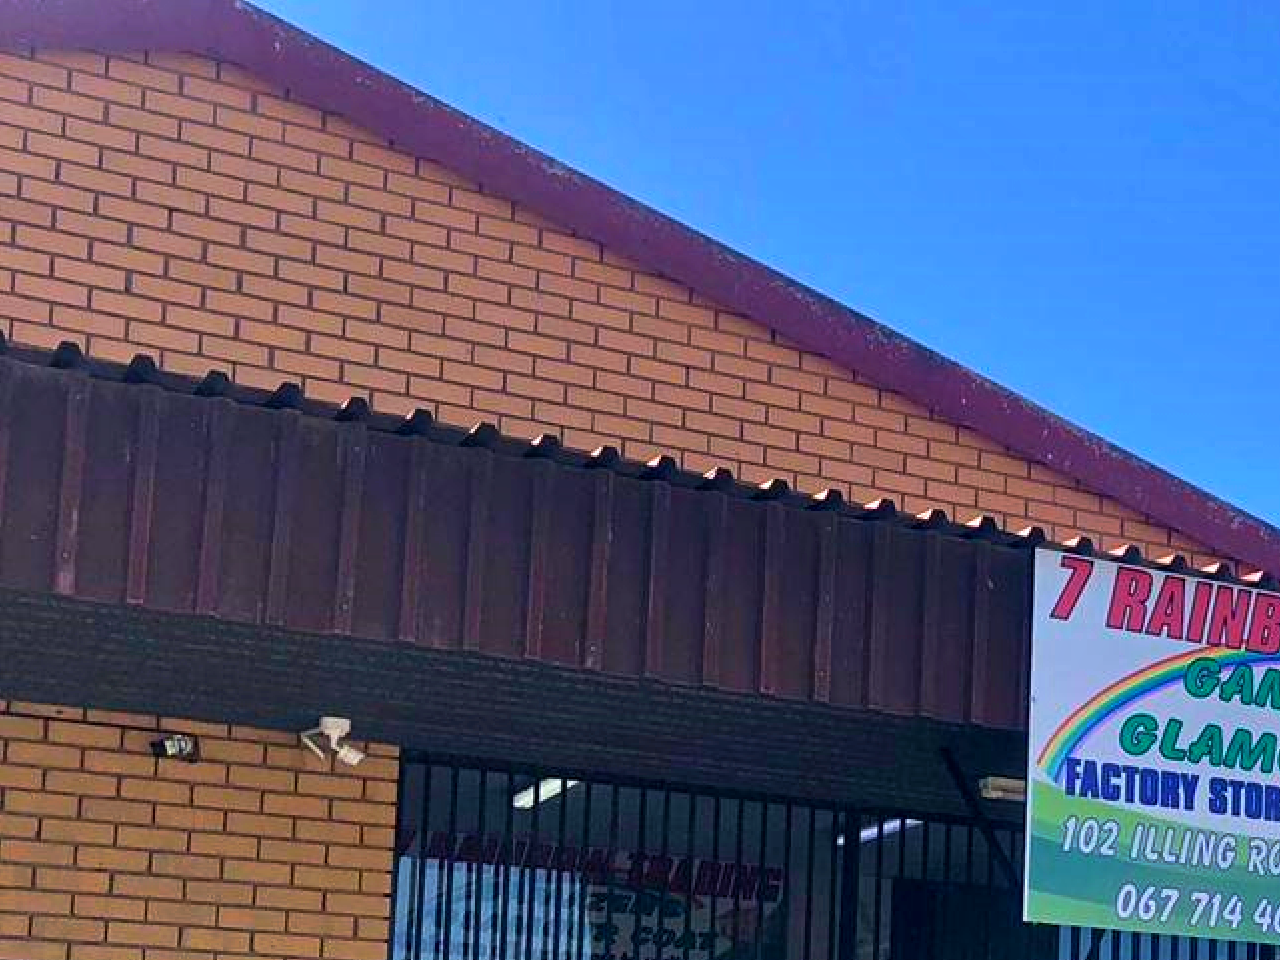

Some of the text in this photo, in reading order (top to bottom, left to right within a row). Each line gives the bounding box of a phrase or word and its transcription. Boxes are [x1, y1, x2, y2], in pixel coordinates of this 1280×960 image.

[1051, 555, 1095, 621] 7
[1065, 758, 1199, 812] FACTORY
[1060, 816, 1119, 857] 102
[1130, 827, 1237, 872] ILLING
[1115, 885, 1179, 922] 067
[1190, 893, 1243, 928] 714
